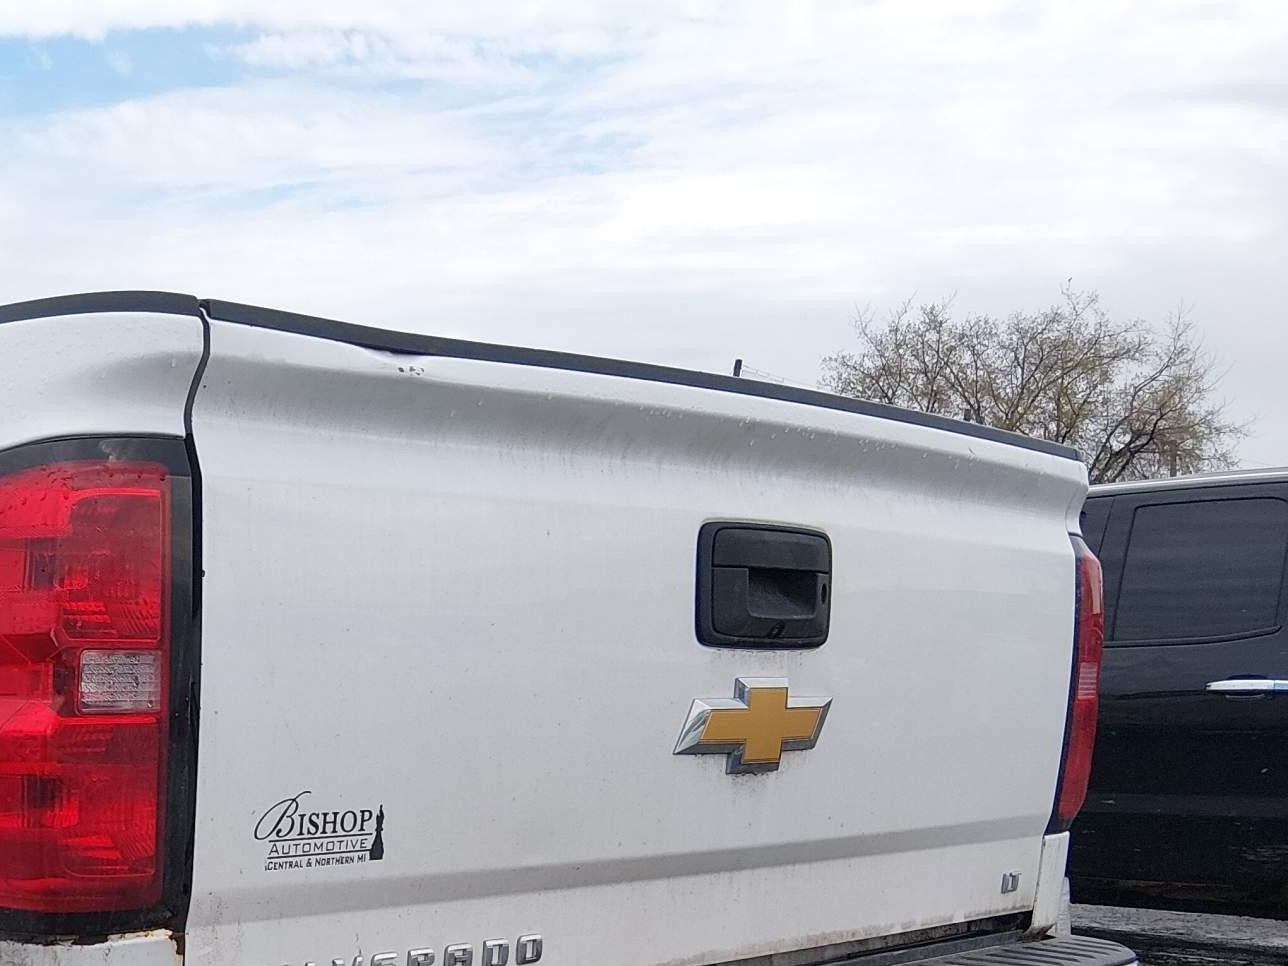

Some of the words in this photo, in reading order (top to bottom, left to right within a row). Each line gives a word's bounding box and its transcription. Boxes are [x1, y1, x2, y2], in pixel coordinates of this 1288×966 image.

[254, 790, 373, 840] BISHOP
[268, 838, 368, 855] AUTOMOTIVE
[266, 859, 304, 871] CENTRAL
[306, 857, 313, 868] &
[315, 854, 355, 867] NORTHERN
[357, 853, 367, 864] MI
